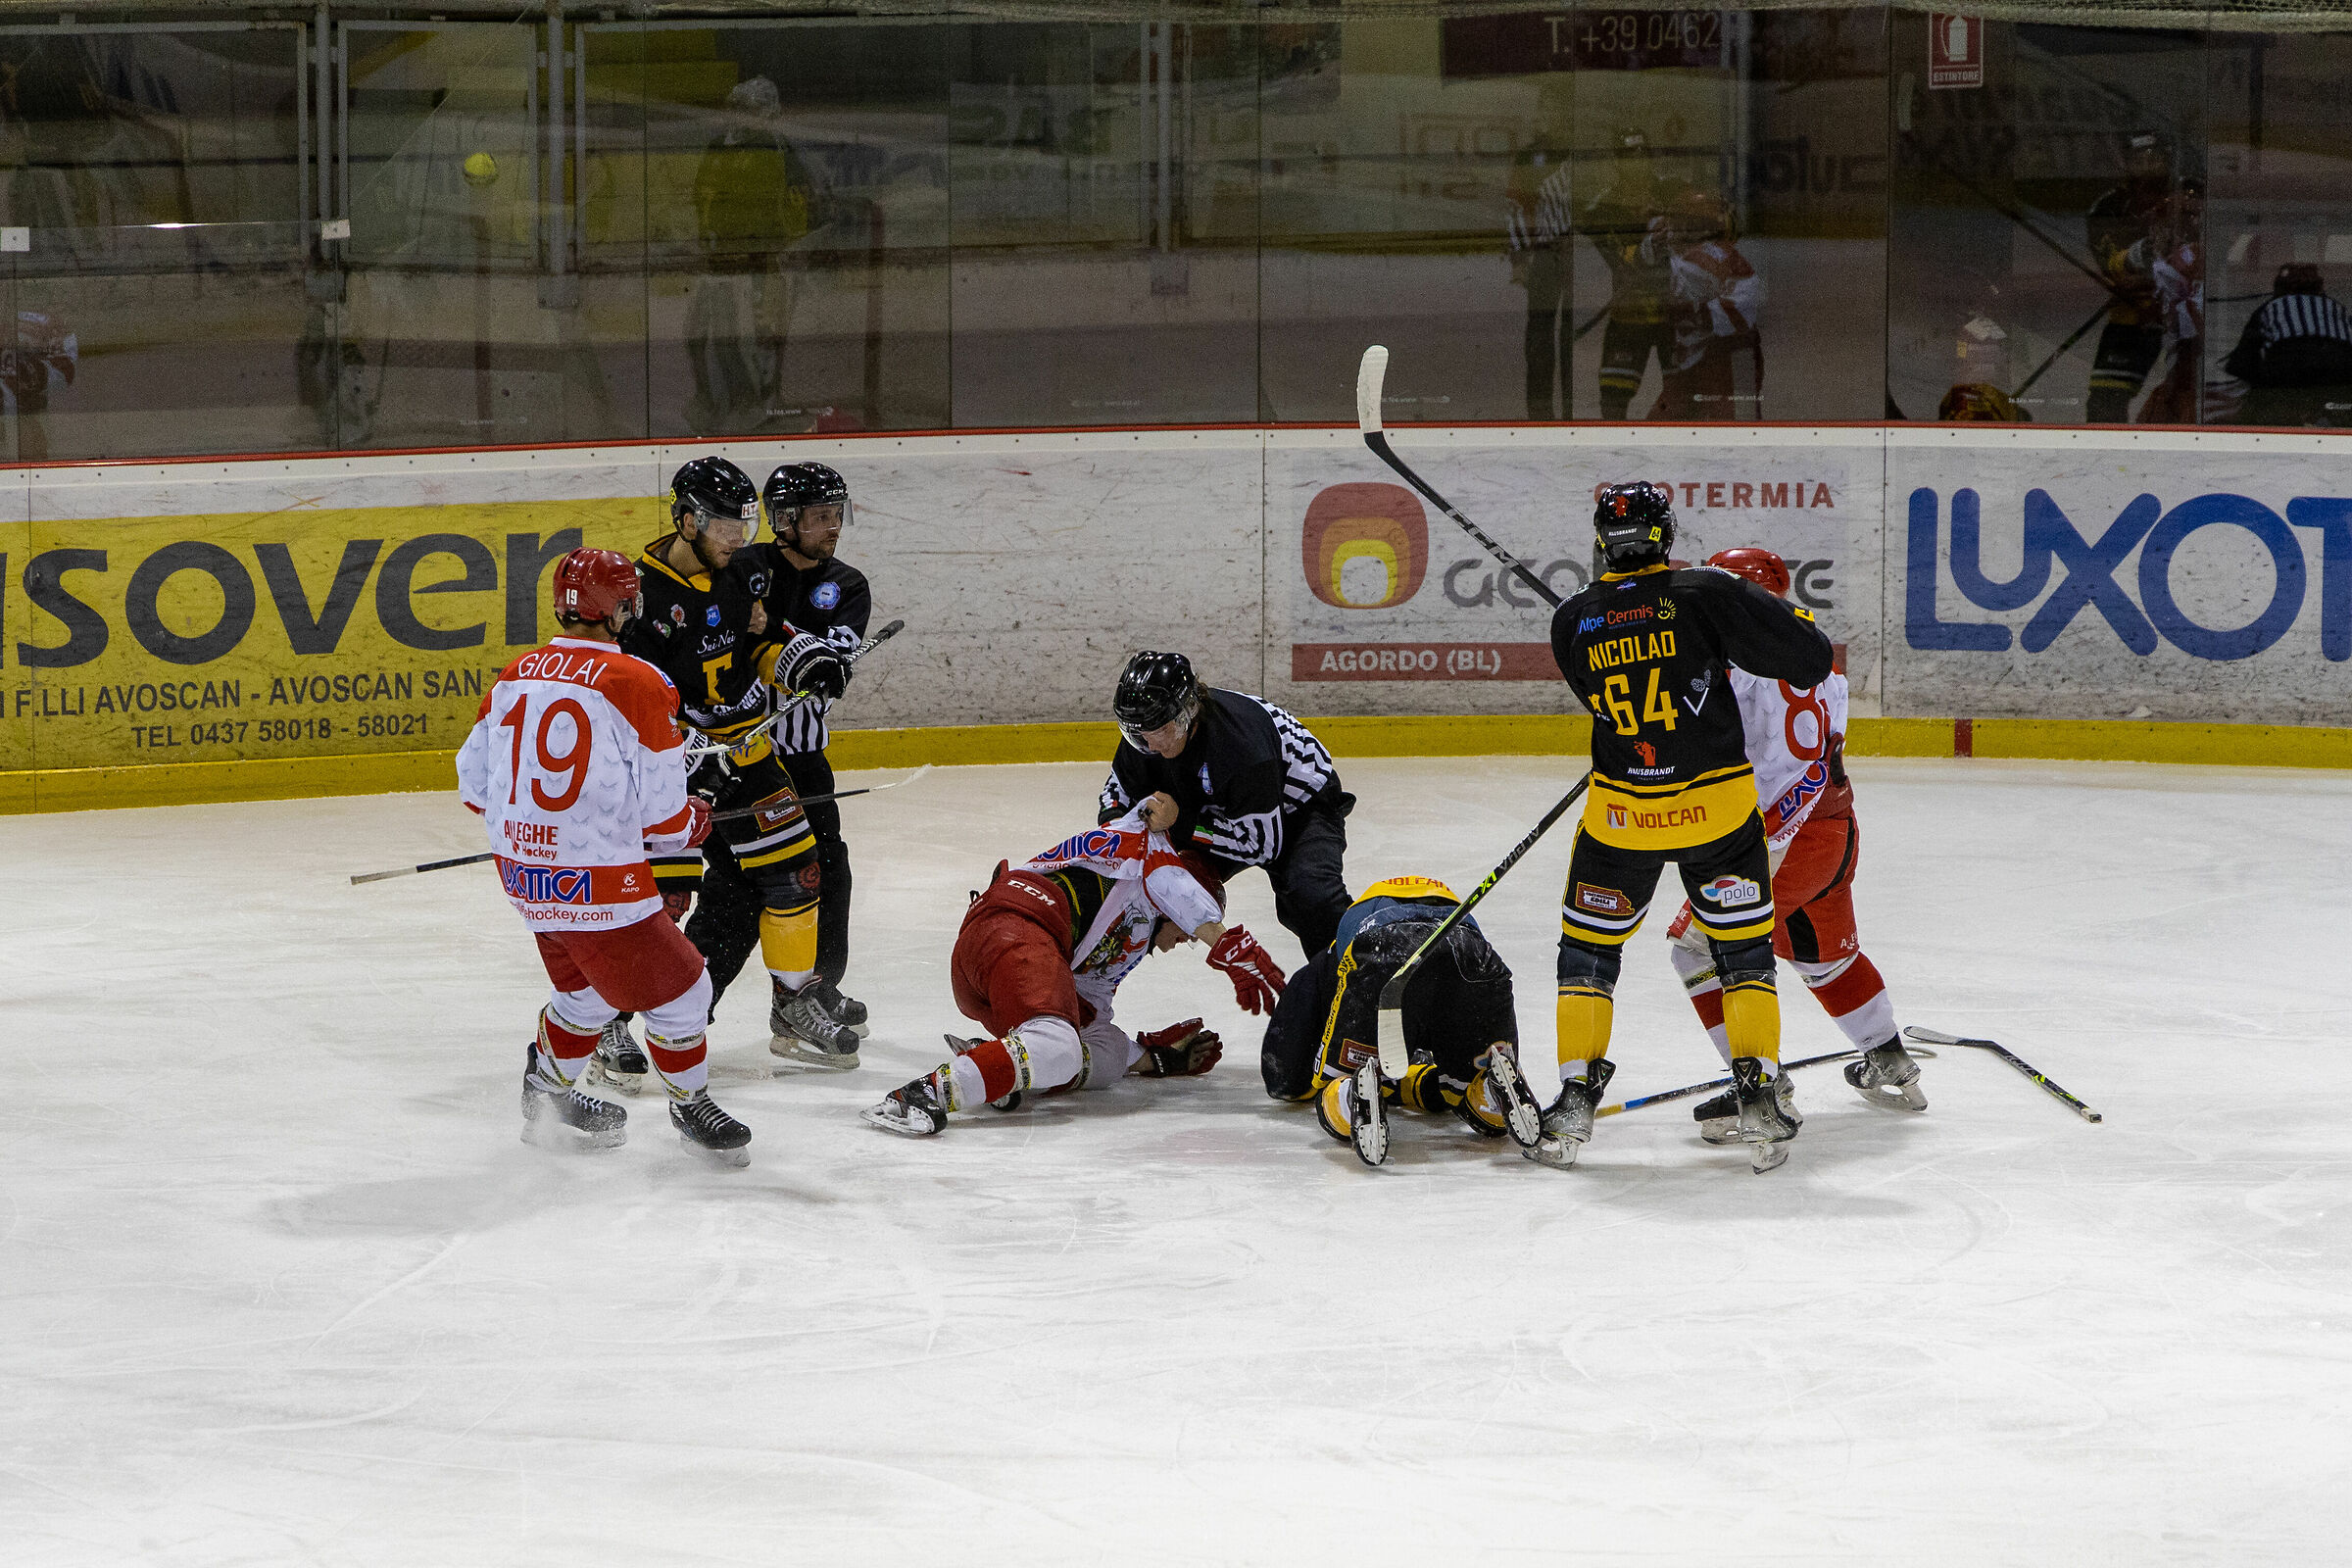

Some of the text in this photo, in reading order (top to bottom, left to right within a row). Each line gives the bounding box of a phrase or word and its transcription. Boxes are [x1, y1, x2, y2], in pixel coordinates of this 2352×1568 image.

[1544, 10, 1721, 54] T. +39 0462
[1933, 69, 1980, 82] ESTINTORE
[0, 527, 582, 668] sover
[565, 588, 578, 605] 19
[1578, 615, 1605, 635] Alpe
[1606, 605, 1654, 625] Cermis
[1320, 649, 1501, 675] AGORDO (BL)
[1588, 630, 1677, 671] NICOLAO
[517, 652, 608, 686] GIOLAI
[95, 679, 240, 714] AVOSCAN
[269, 672, 414, 705] AVOSCAN
[423, 668, 481, 697] SAN
[1604, 667, 1679, 736] 64
[132, 725, 181, 749] TEL
[191, 721, 249, 745] 0437
[258, 718, 331, 742] 58018
[358, 714, 427, 737] 58021
[499, 694, 593, 811] 19
[1633, 805, 1707, 829] VOLCAN
[504, 819, 559, 847] ALLEGHE
[521, 845, 558, 861] Hockey
[1007, 879, 1056, 906] CCM
[1724, 884, 1756, 905] polo
